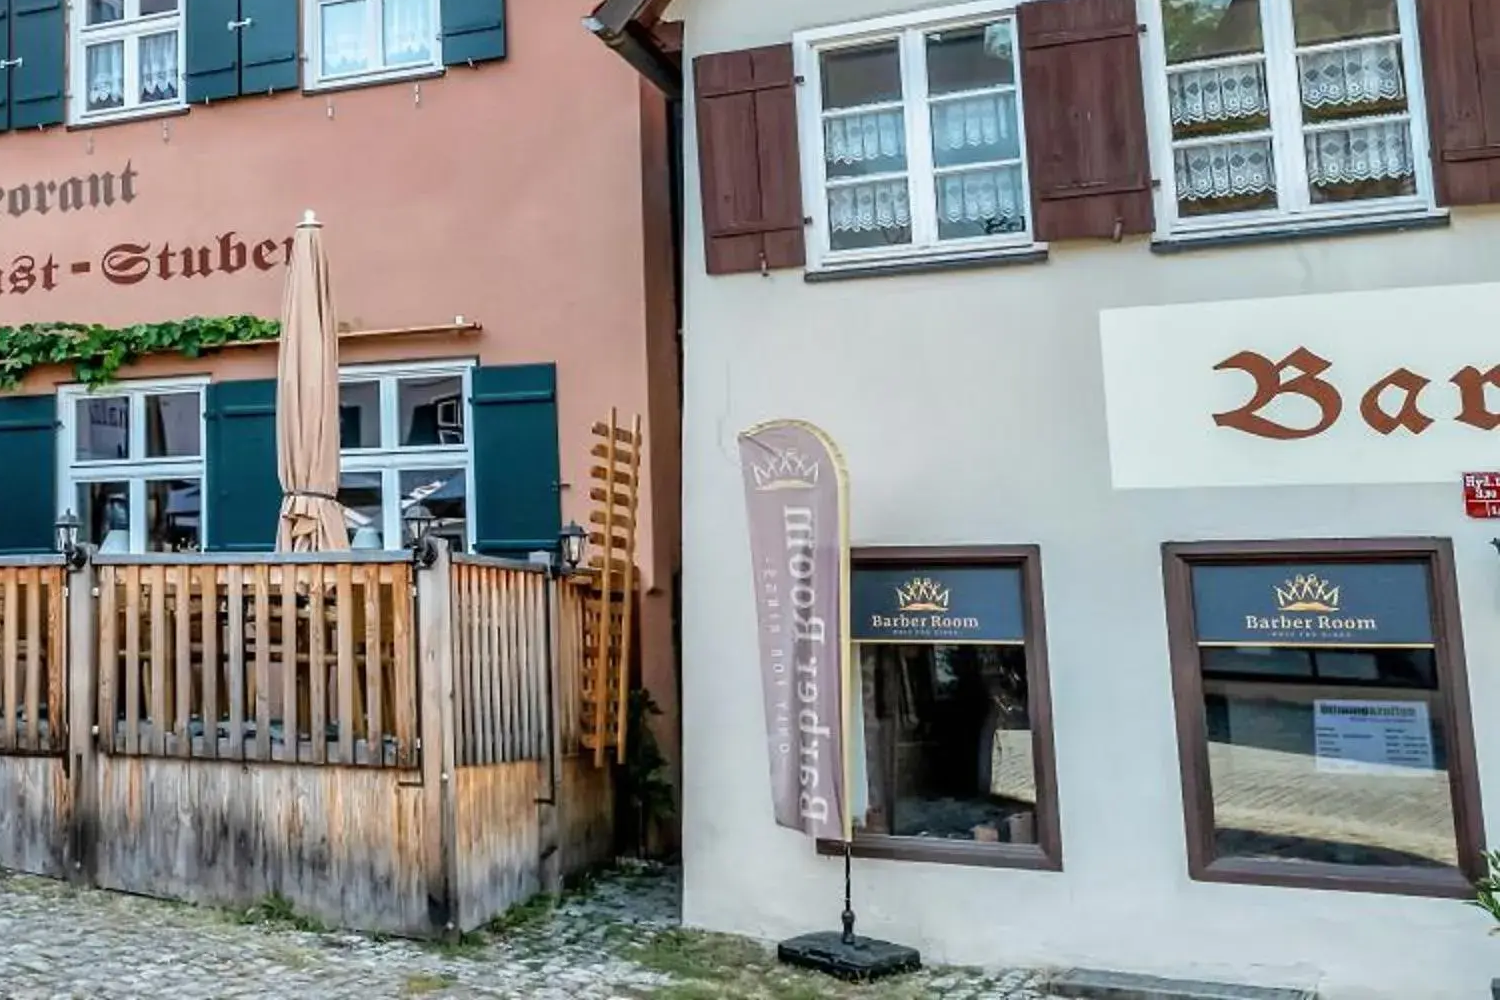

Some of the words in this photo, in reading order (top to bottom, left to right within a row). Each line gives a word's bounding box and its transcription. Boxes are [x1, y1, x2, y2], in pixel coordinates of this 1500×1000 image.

[872, 614, 926, 628] Barber
[931, 616, 979, 628] Room
[1245, 615, 1314, 629] Barber
[1317, 615, 1377, 629] Room
